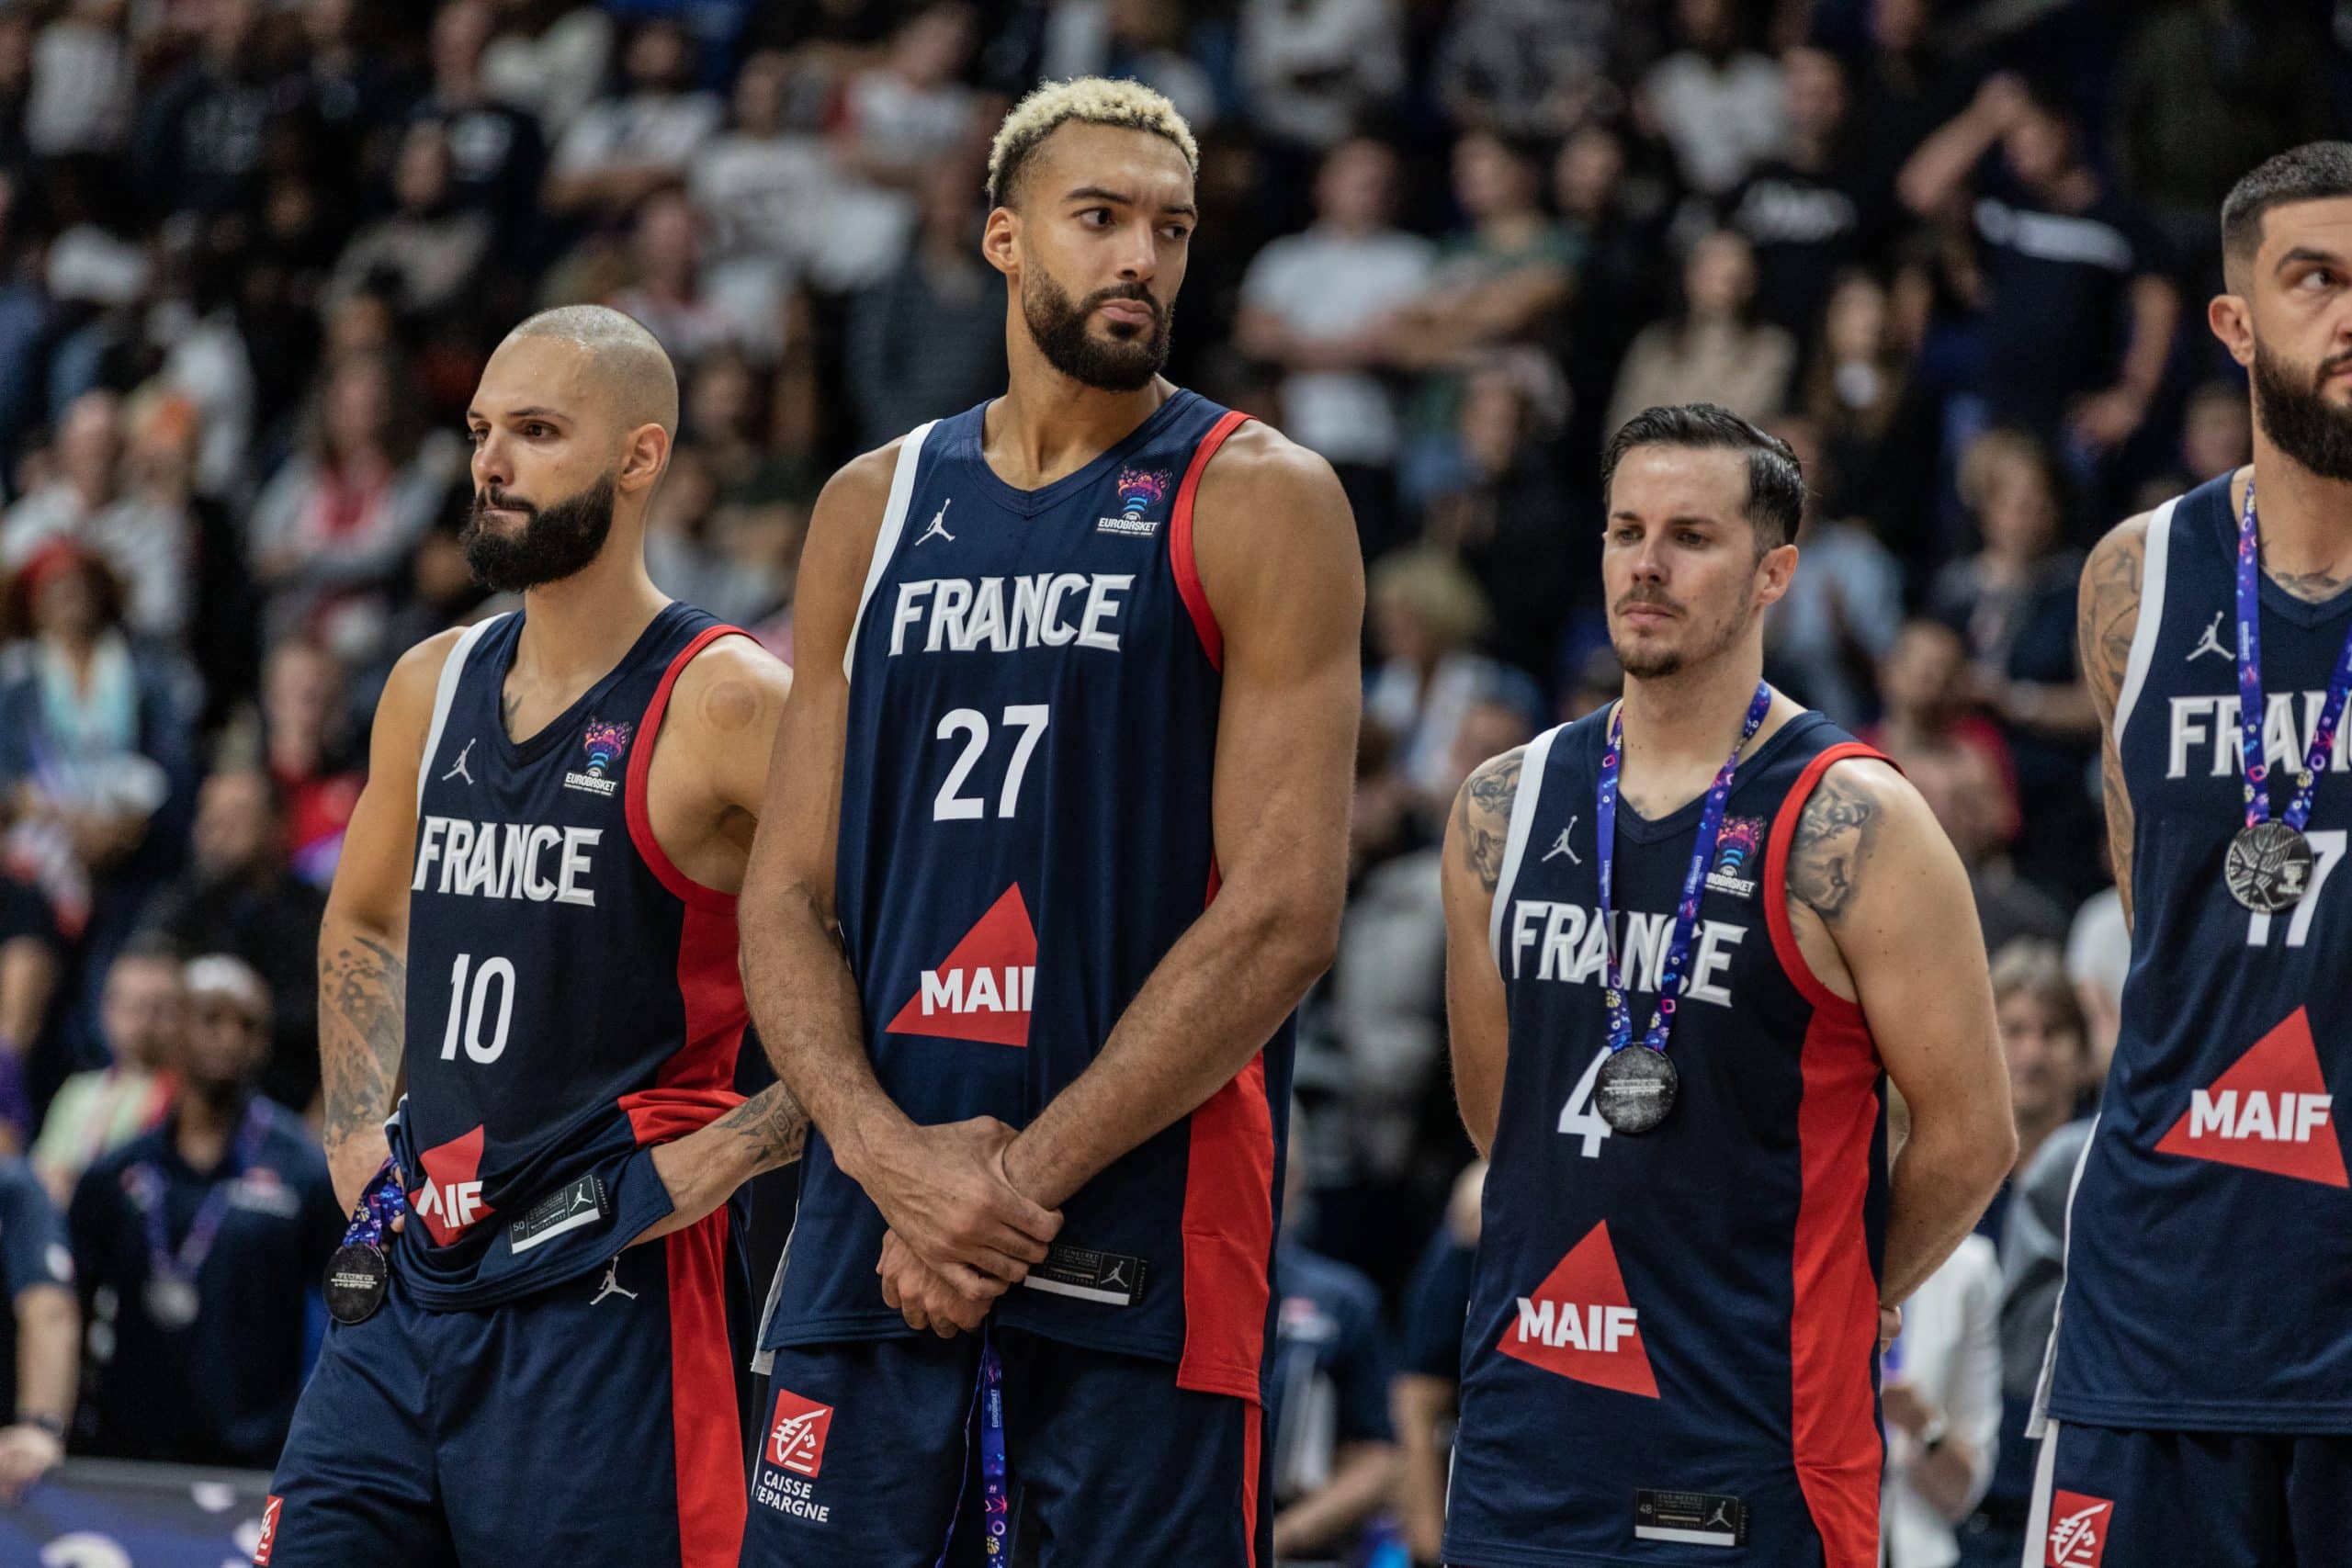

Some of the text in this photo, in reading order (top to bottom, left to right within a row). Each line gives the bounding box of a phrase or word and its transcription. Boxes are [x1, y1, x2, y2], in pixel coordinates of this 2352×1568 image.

[1098, 517, 1158, 532] EUROBASKET
[888, 572, 1136, 658] FRANCE
[933, 704, 1050, 822] 27
[2165, 690, 2352, 780] FRAN
[411, 815, 604, 908] FRANCE
[1511, 899, 1749, 1009] FRANCE
[440, 953, 516, 1065] 10
[1557, 1045, 1613, 1158] 4
[2188, 1089, 2334, 1143] MAIF
[1516, 1296, 1638, 1353] MAIF
[763, 1470, 813, 1500] CAISSE
